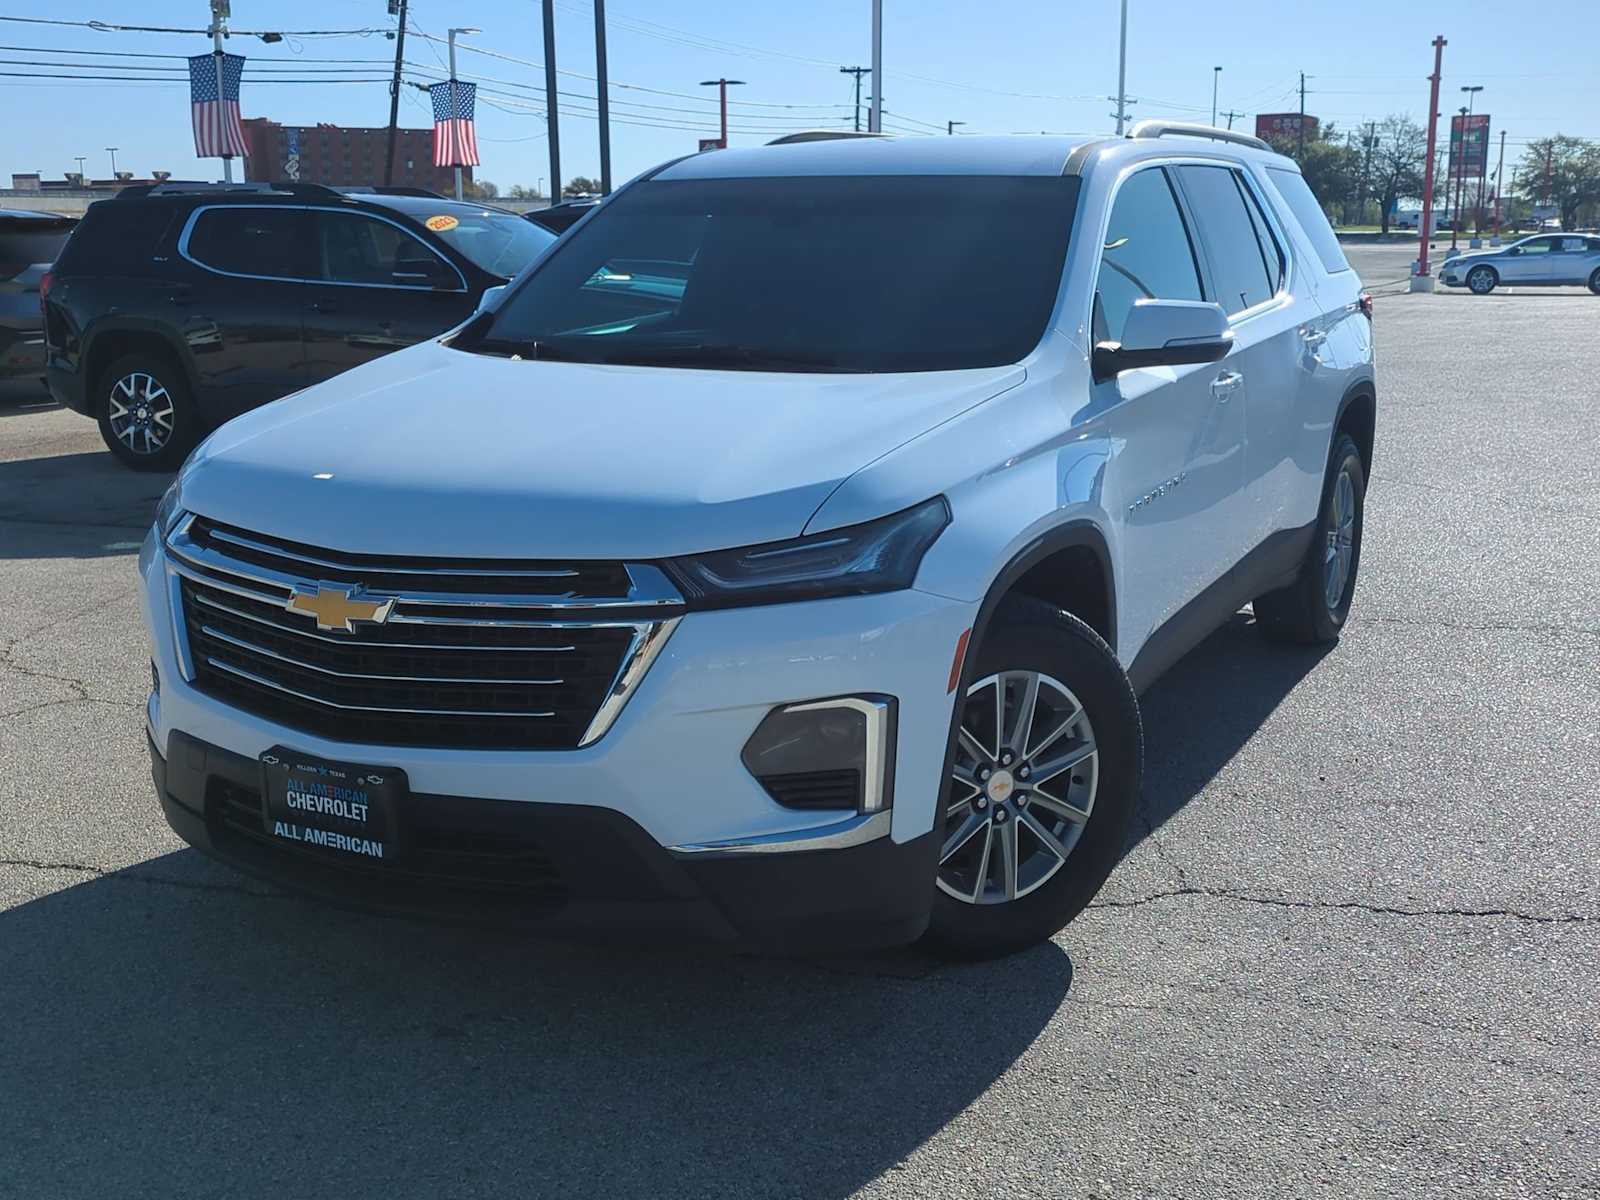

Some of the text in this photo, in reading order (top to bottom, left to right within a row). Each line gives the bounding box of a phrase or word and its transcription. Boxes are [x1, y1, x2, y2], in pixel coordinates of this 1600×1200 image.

[286, 790, 369, 822] CHEVROLET
[287, 778, 369, 804] ALL AMERICAN
[274, 821, 384, 858] ALL AMERICAN
